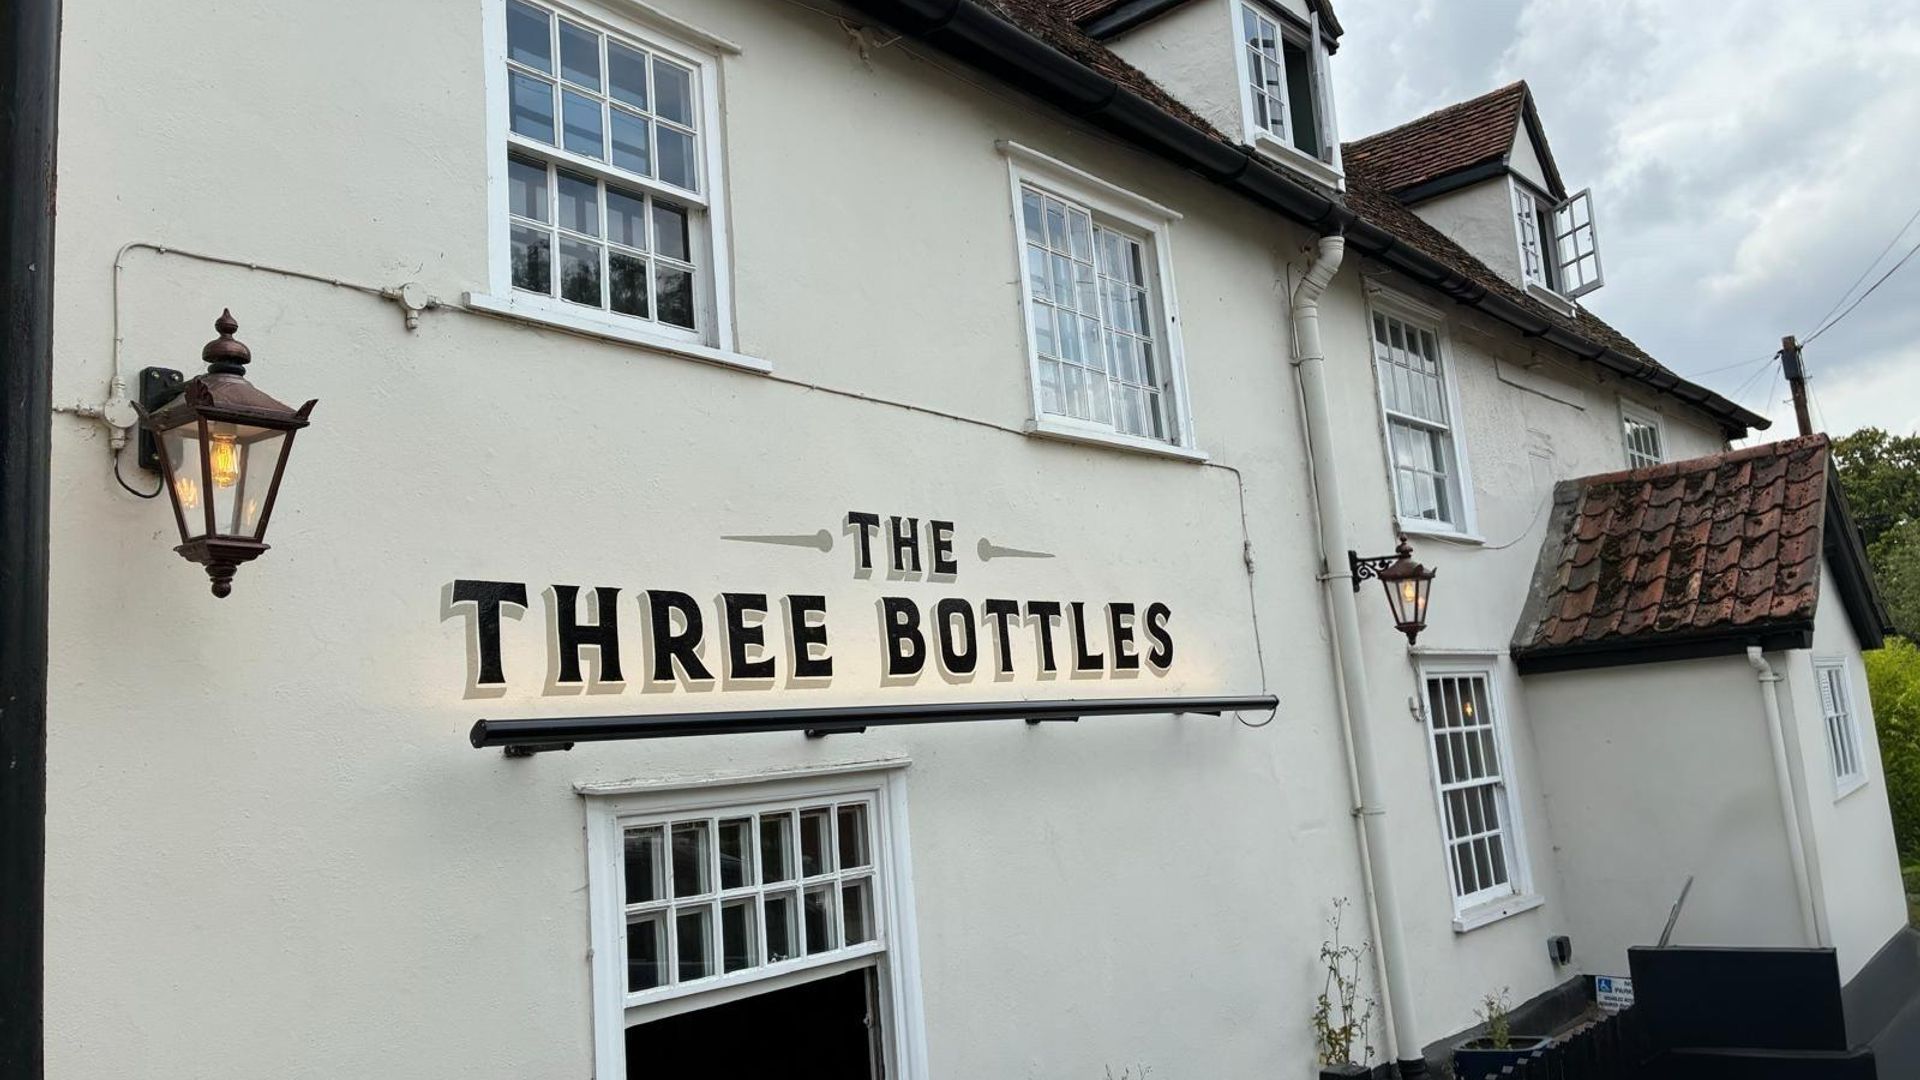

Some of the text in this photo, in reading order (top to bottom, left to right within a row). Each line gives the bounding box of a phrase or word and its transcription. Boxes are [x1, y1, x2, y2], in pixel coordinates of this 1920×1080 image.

[847, 511, 958, 577] THE
[447, 579, 1174, 690] THREE BOTTLES
